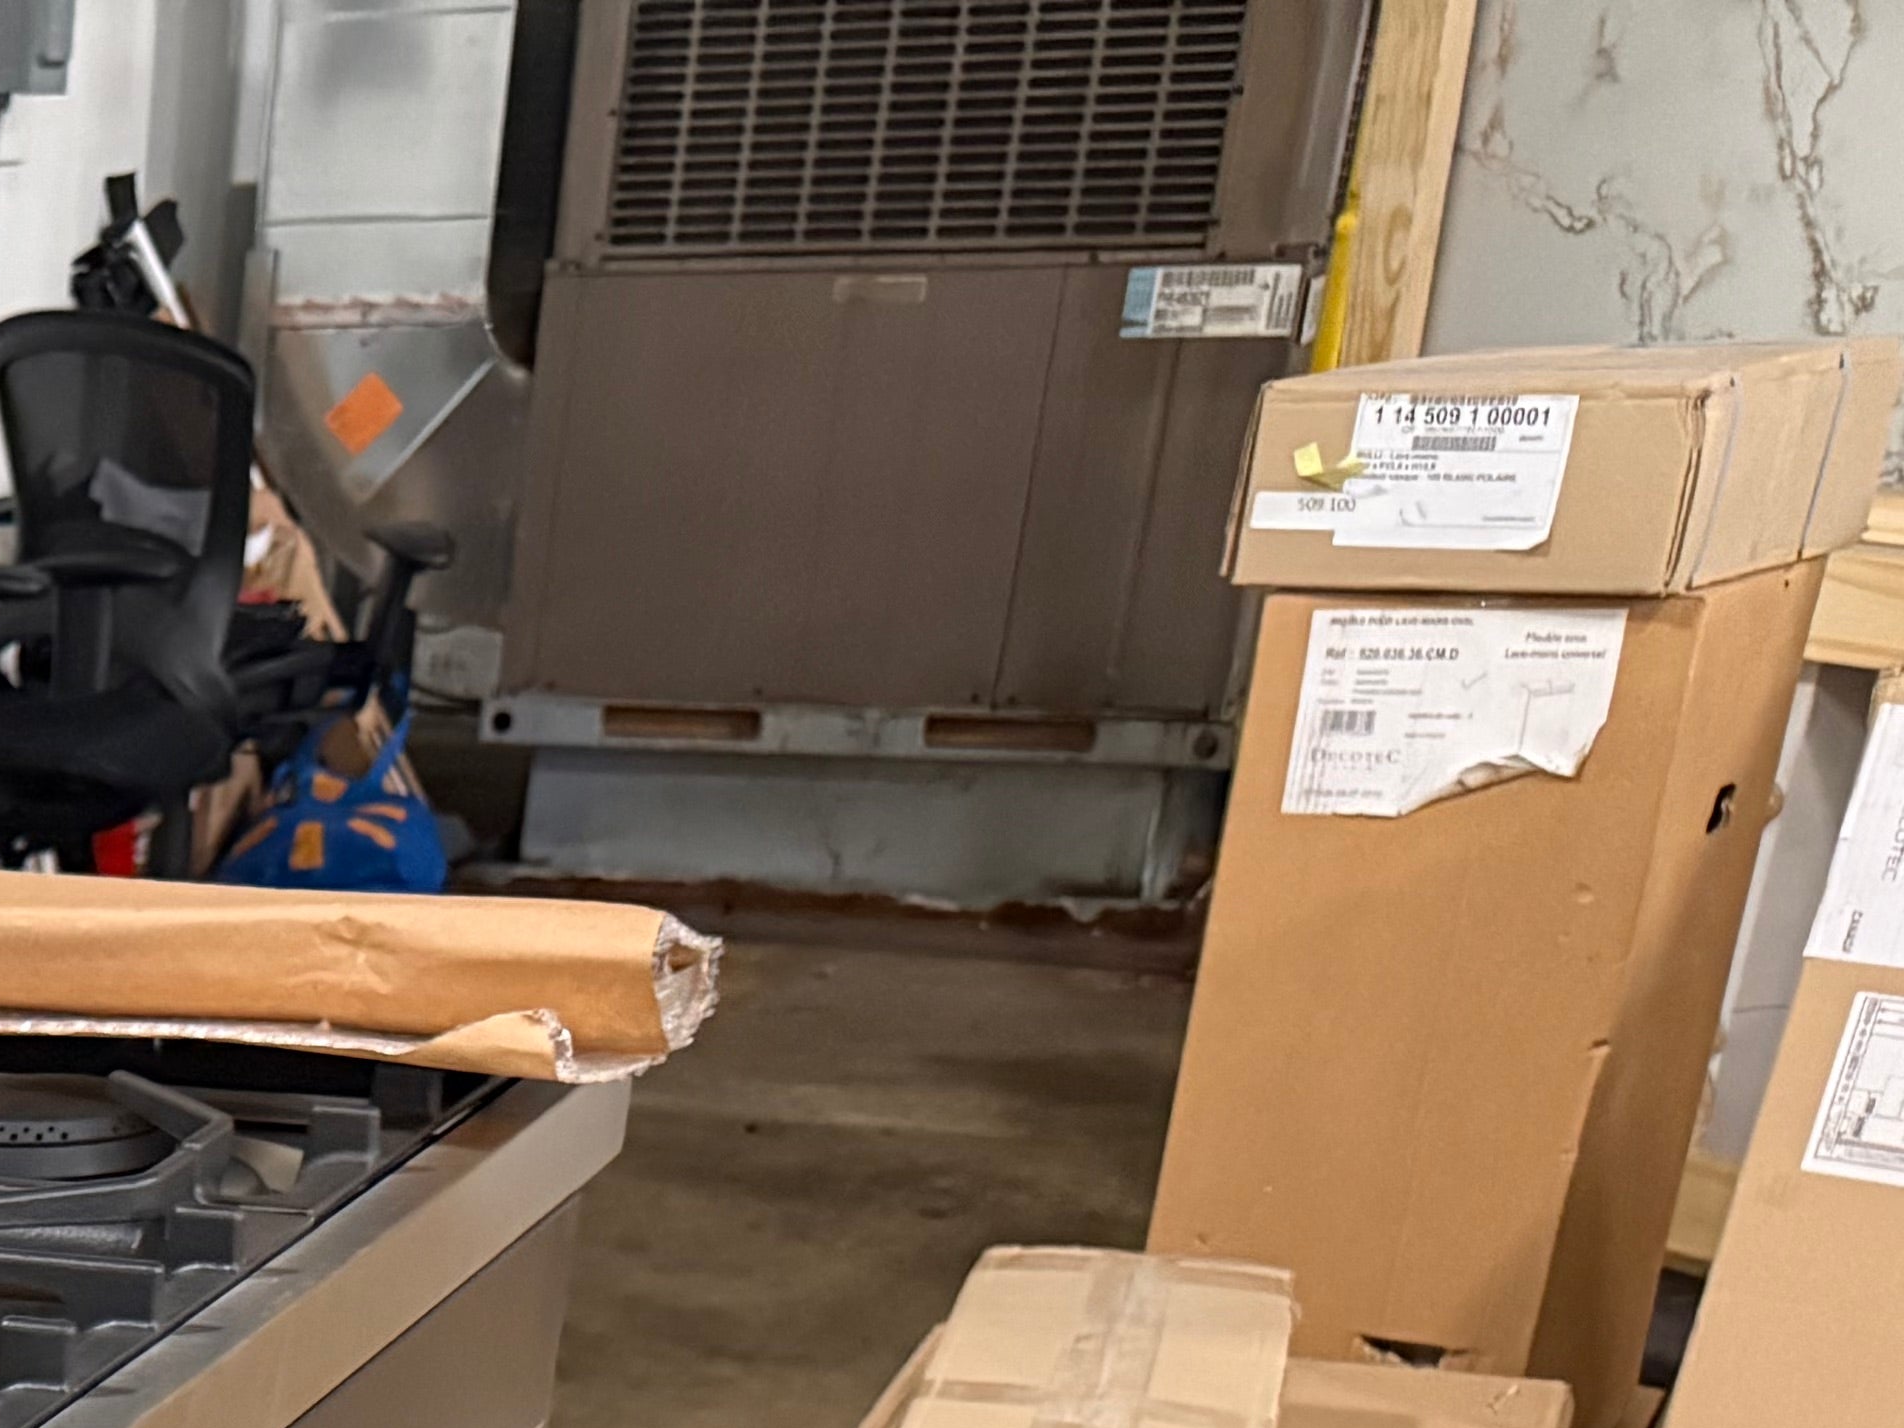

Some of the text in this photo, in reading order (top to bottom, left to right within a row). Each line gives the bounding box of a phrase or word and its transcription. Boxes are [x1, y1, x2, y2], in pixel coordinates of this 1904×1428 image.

[1375, 407, 1551, 427] 1 14 509 1 00001
